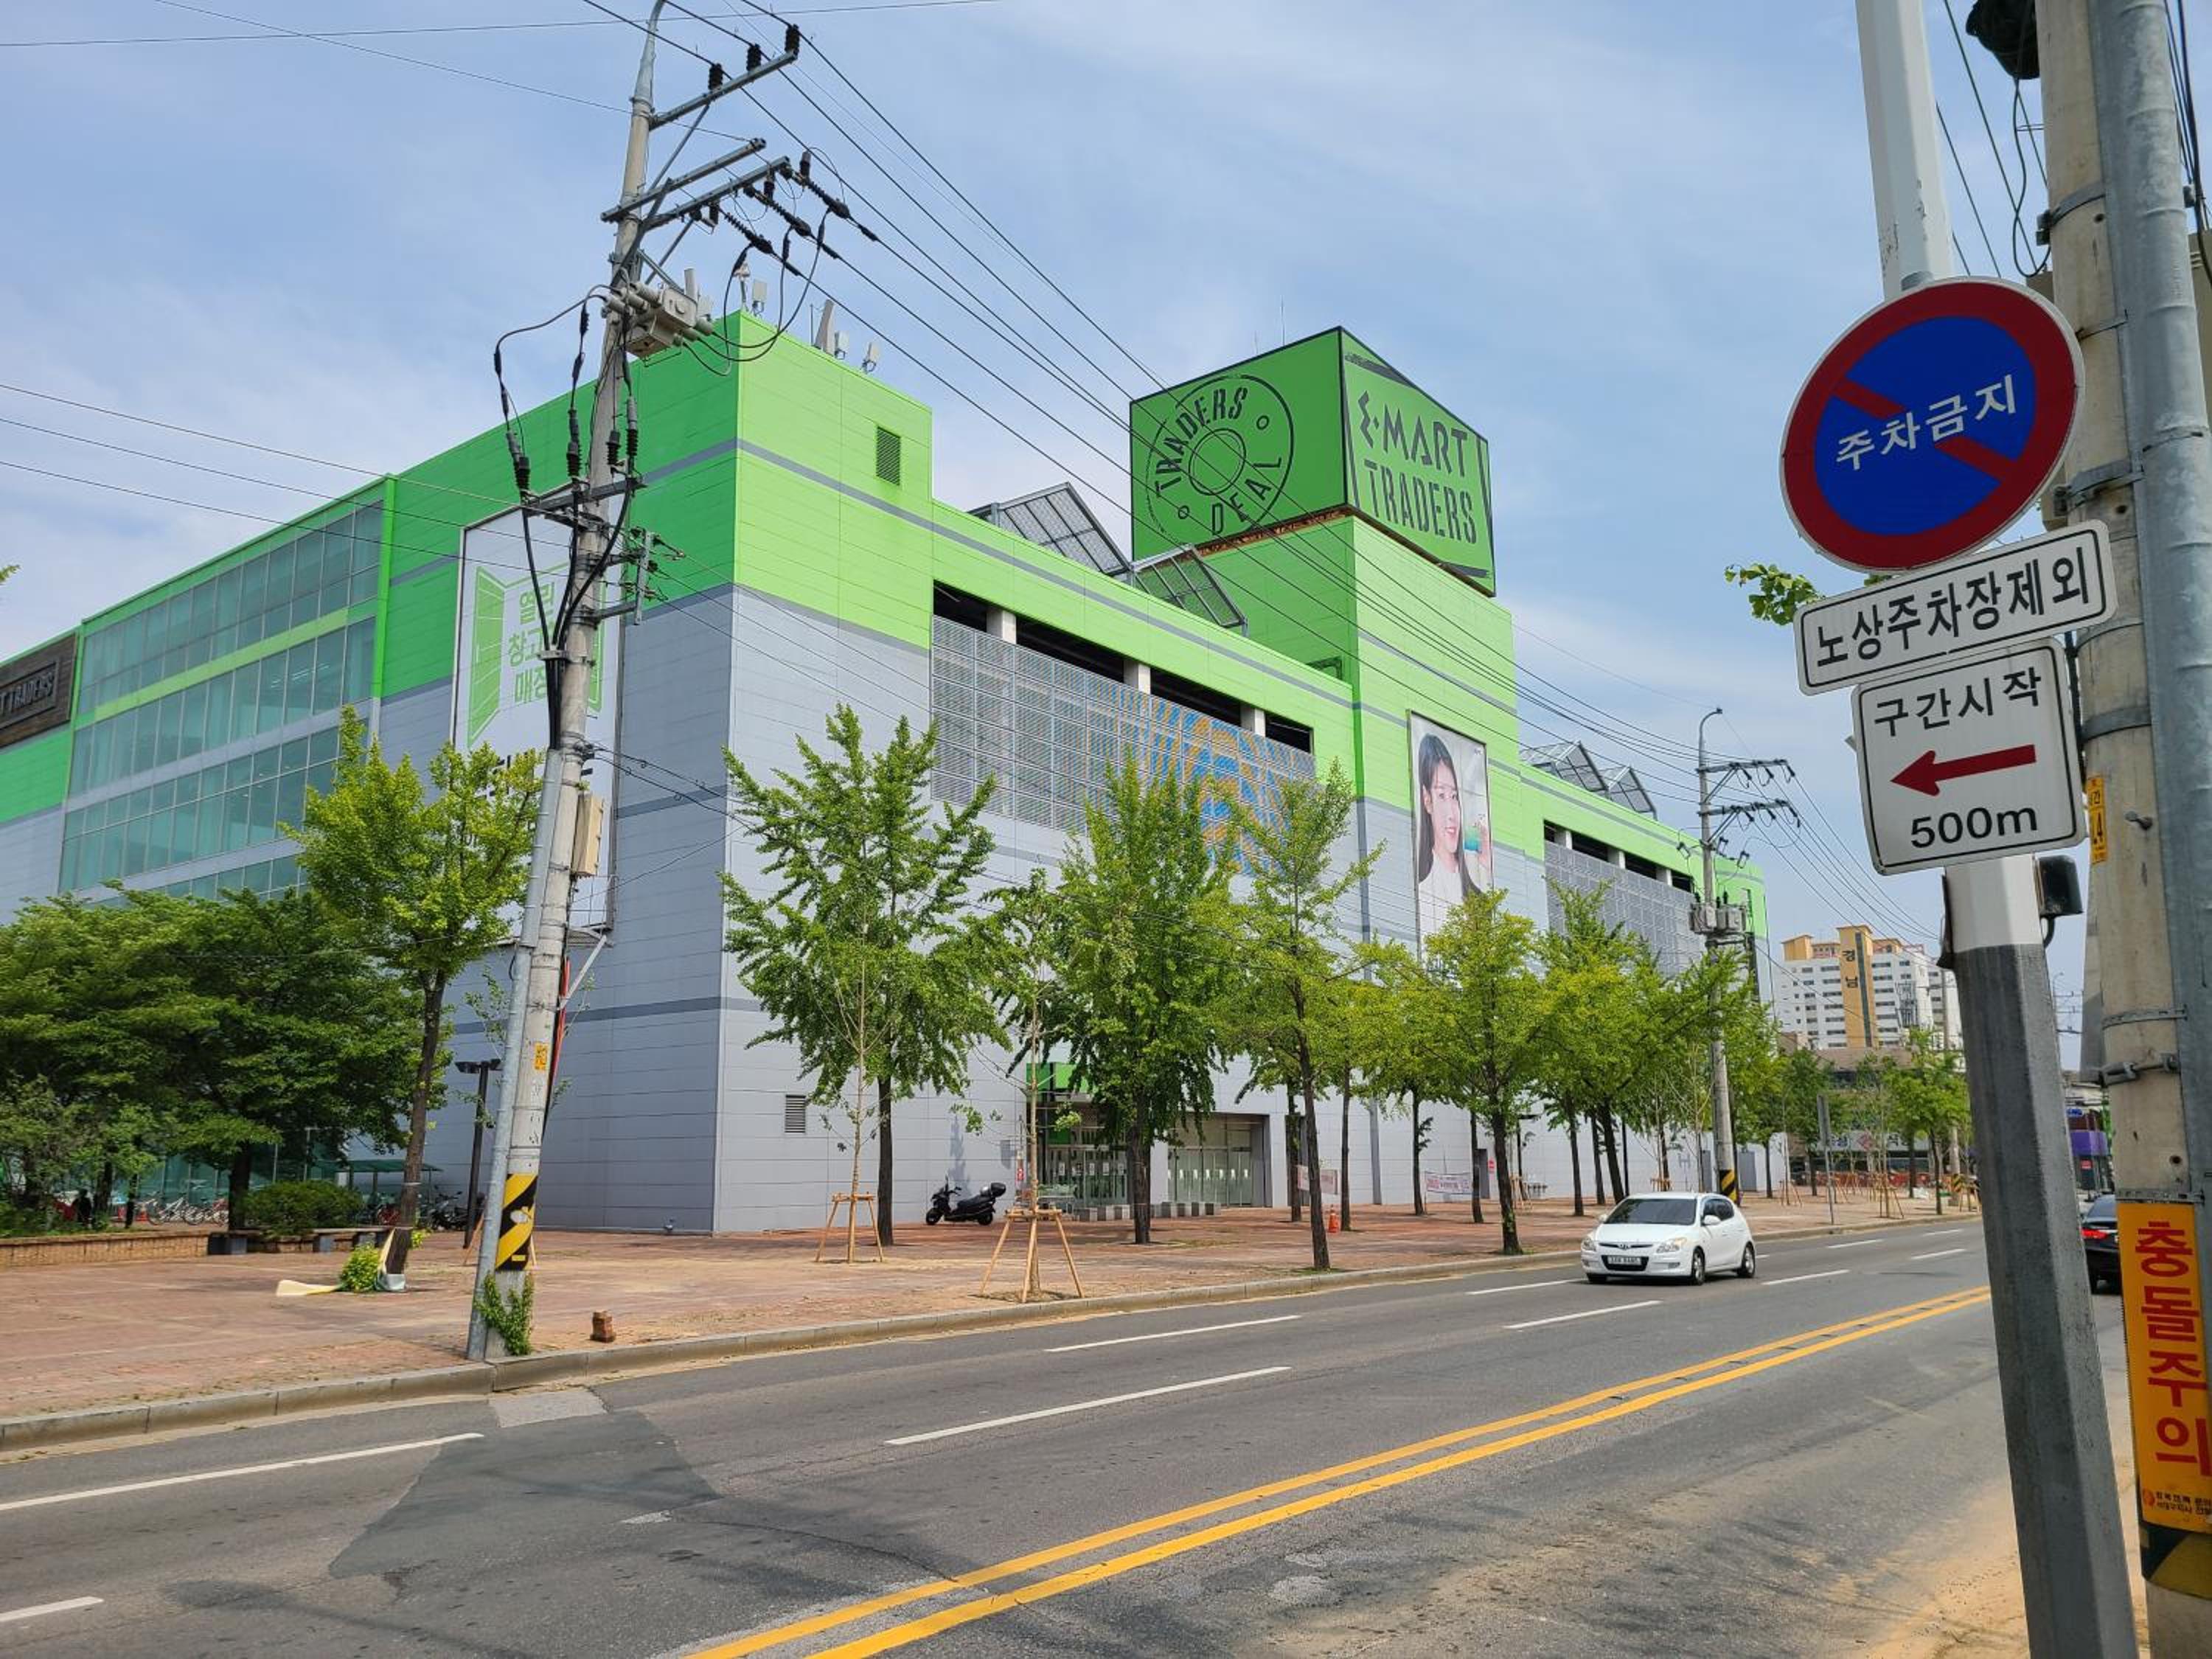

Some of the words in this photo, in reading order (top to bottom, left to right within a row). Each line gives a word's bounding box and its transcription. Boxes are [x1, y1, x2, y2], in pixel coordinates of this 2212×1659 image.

[1155, 387, 1248, 498] TRADERS
[1835, 374, 2017, 471] 주차금지
[1211, 456, 1282, 535] DEAL
[1363, 459, 1477, 544] TRADERS
[1816, 546, 2090, 668] 노상주차장제외
[1874, 666, 2042, 737] 구간시작
[1910, 806, 2038, 849] 500m
[2134, 1220, 2212, 1477] 충돌주의
